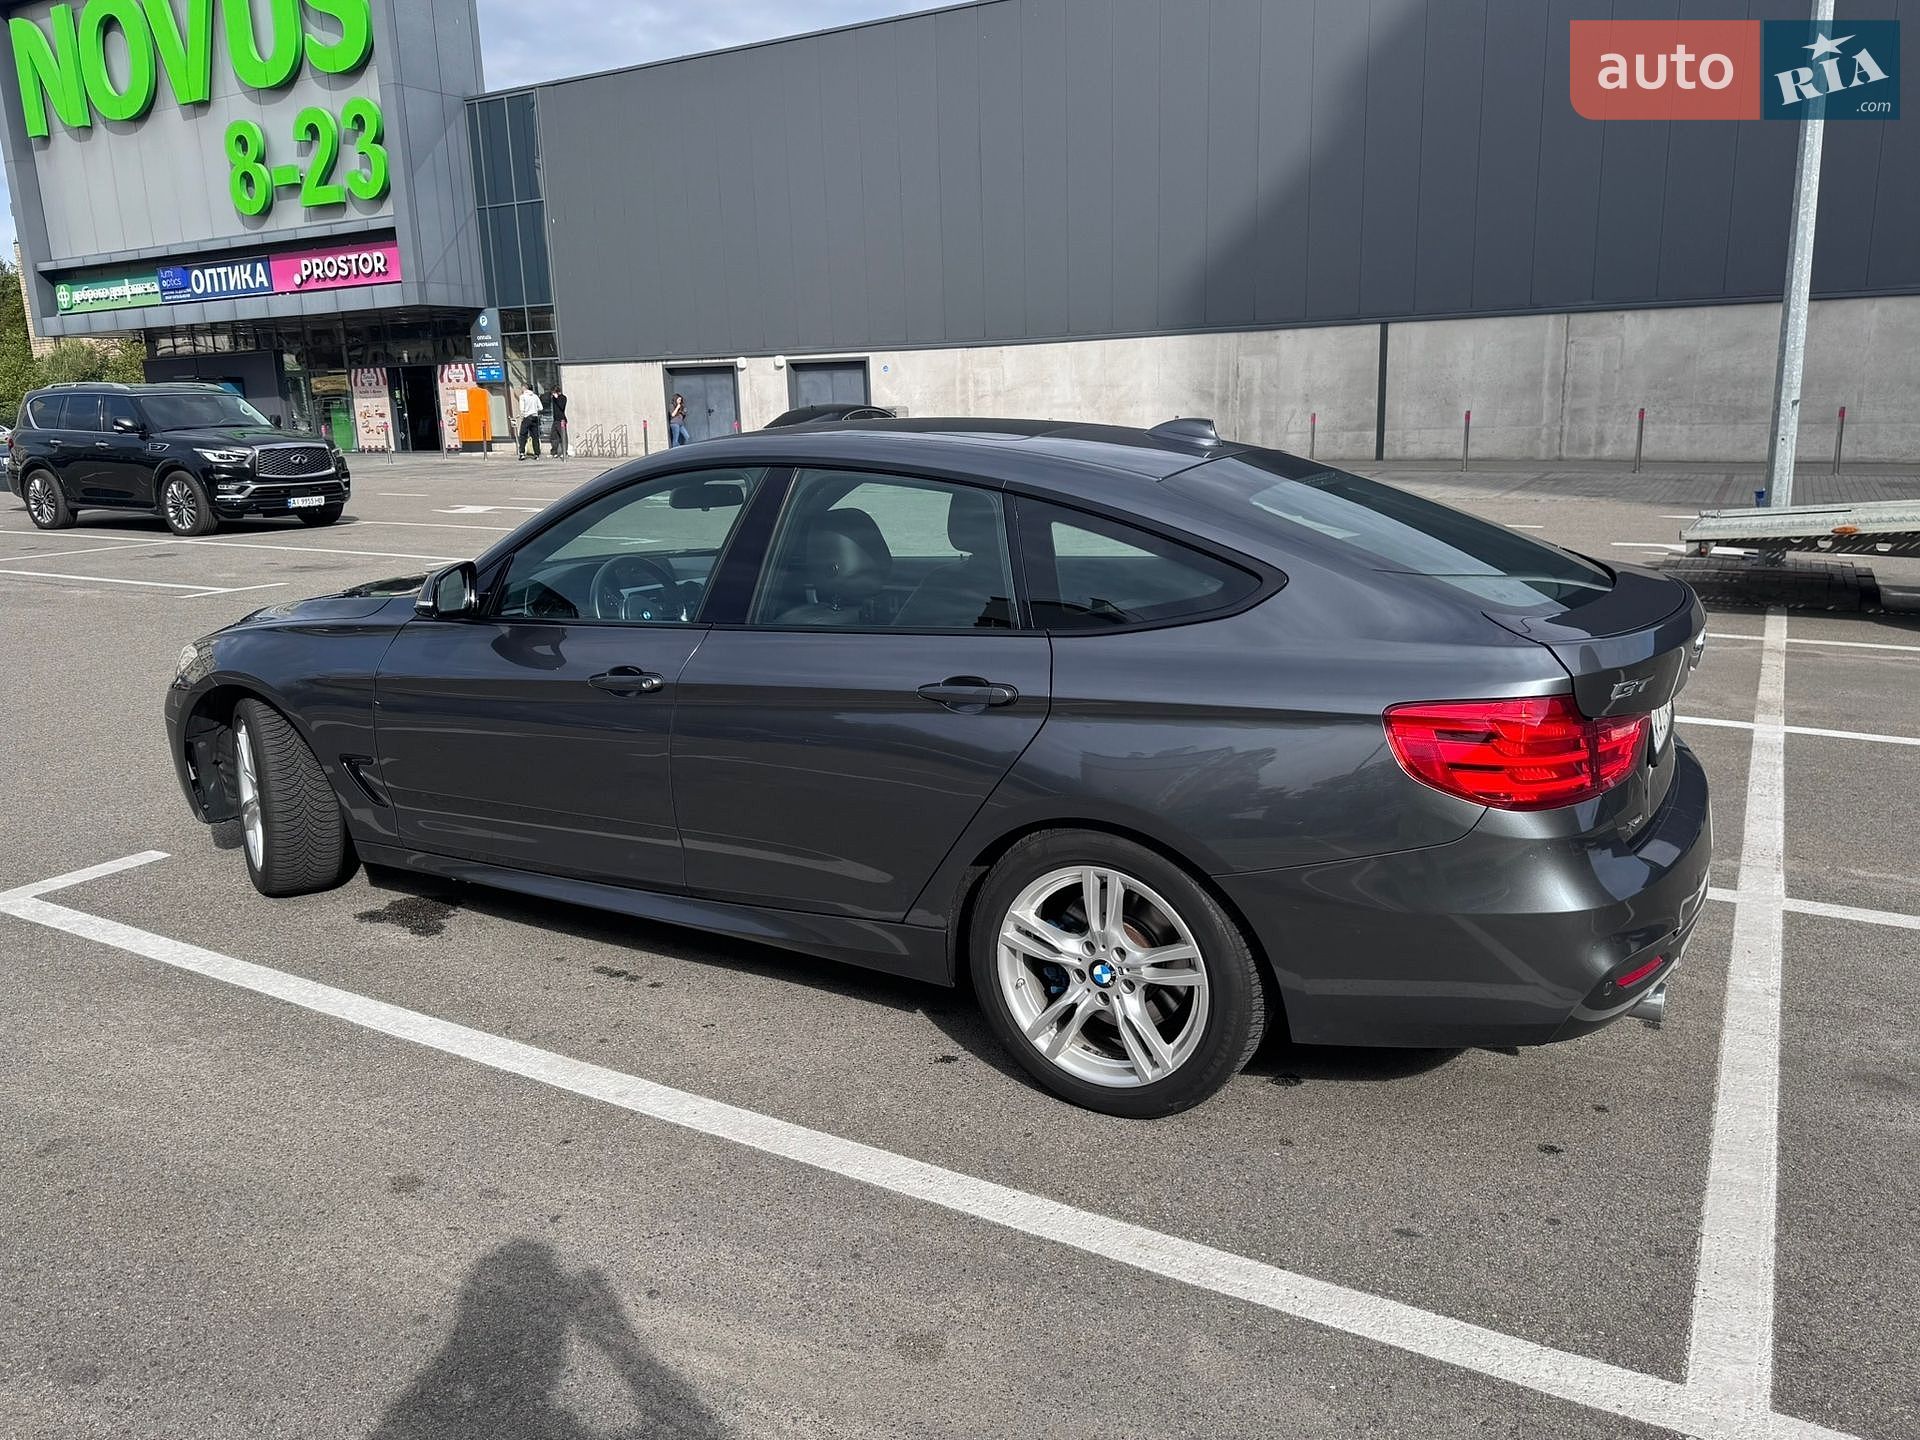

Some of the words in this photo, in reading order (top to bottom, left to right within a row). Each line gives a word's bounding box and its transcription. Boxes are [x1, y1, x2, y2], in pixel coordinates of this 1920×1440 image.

[8, 0, 373, 138] NOVUS
[225, 96, 389, 216] 8-23
[191, 263, 269, 294] ОПТИКА
